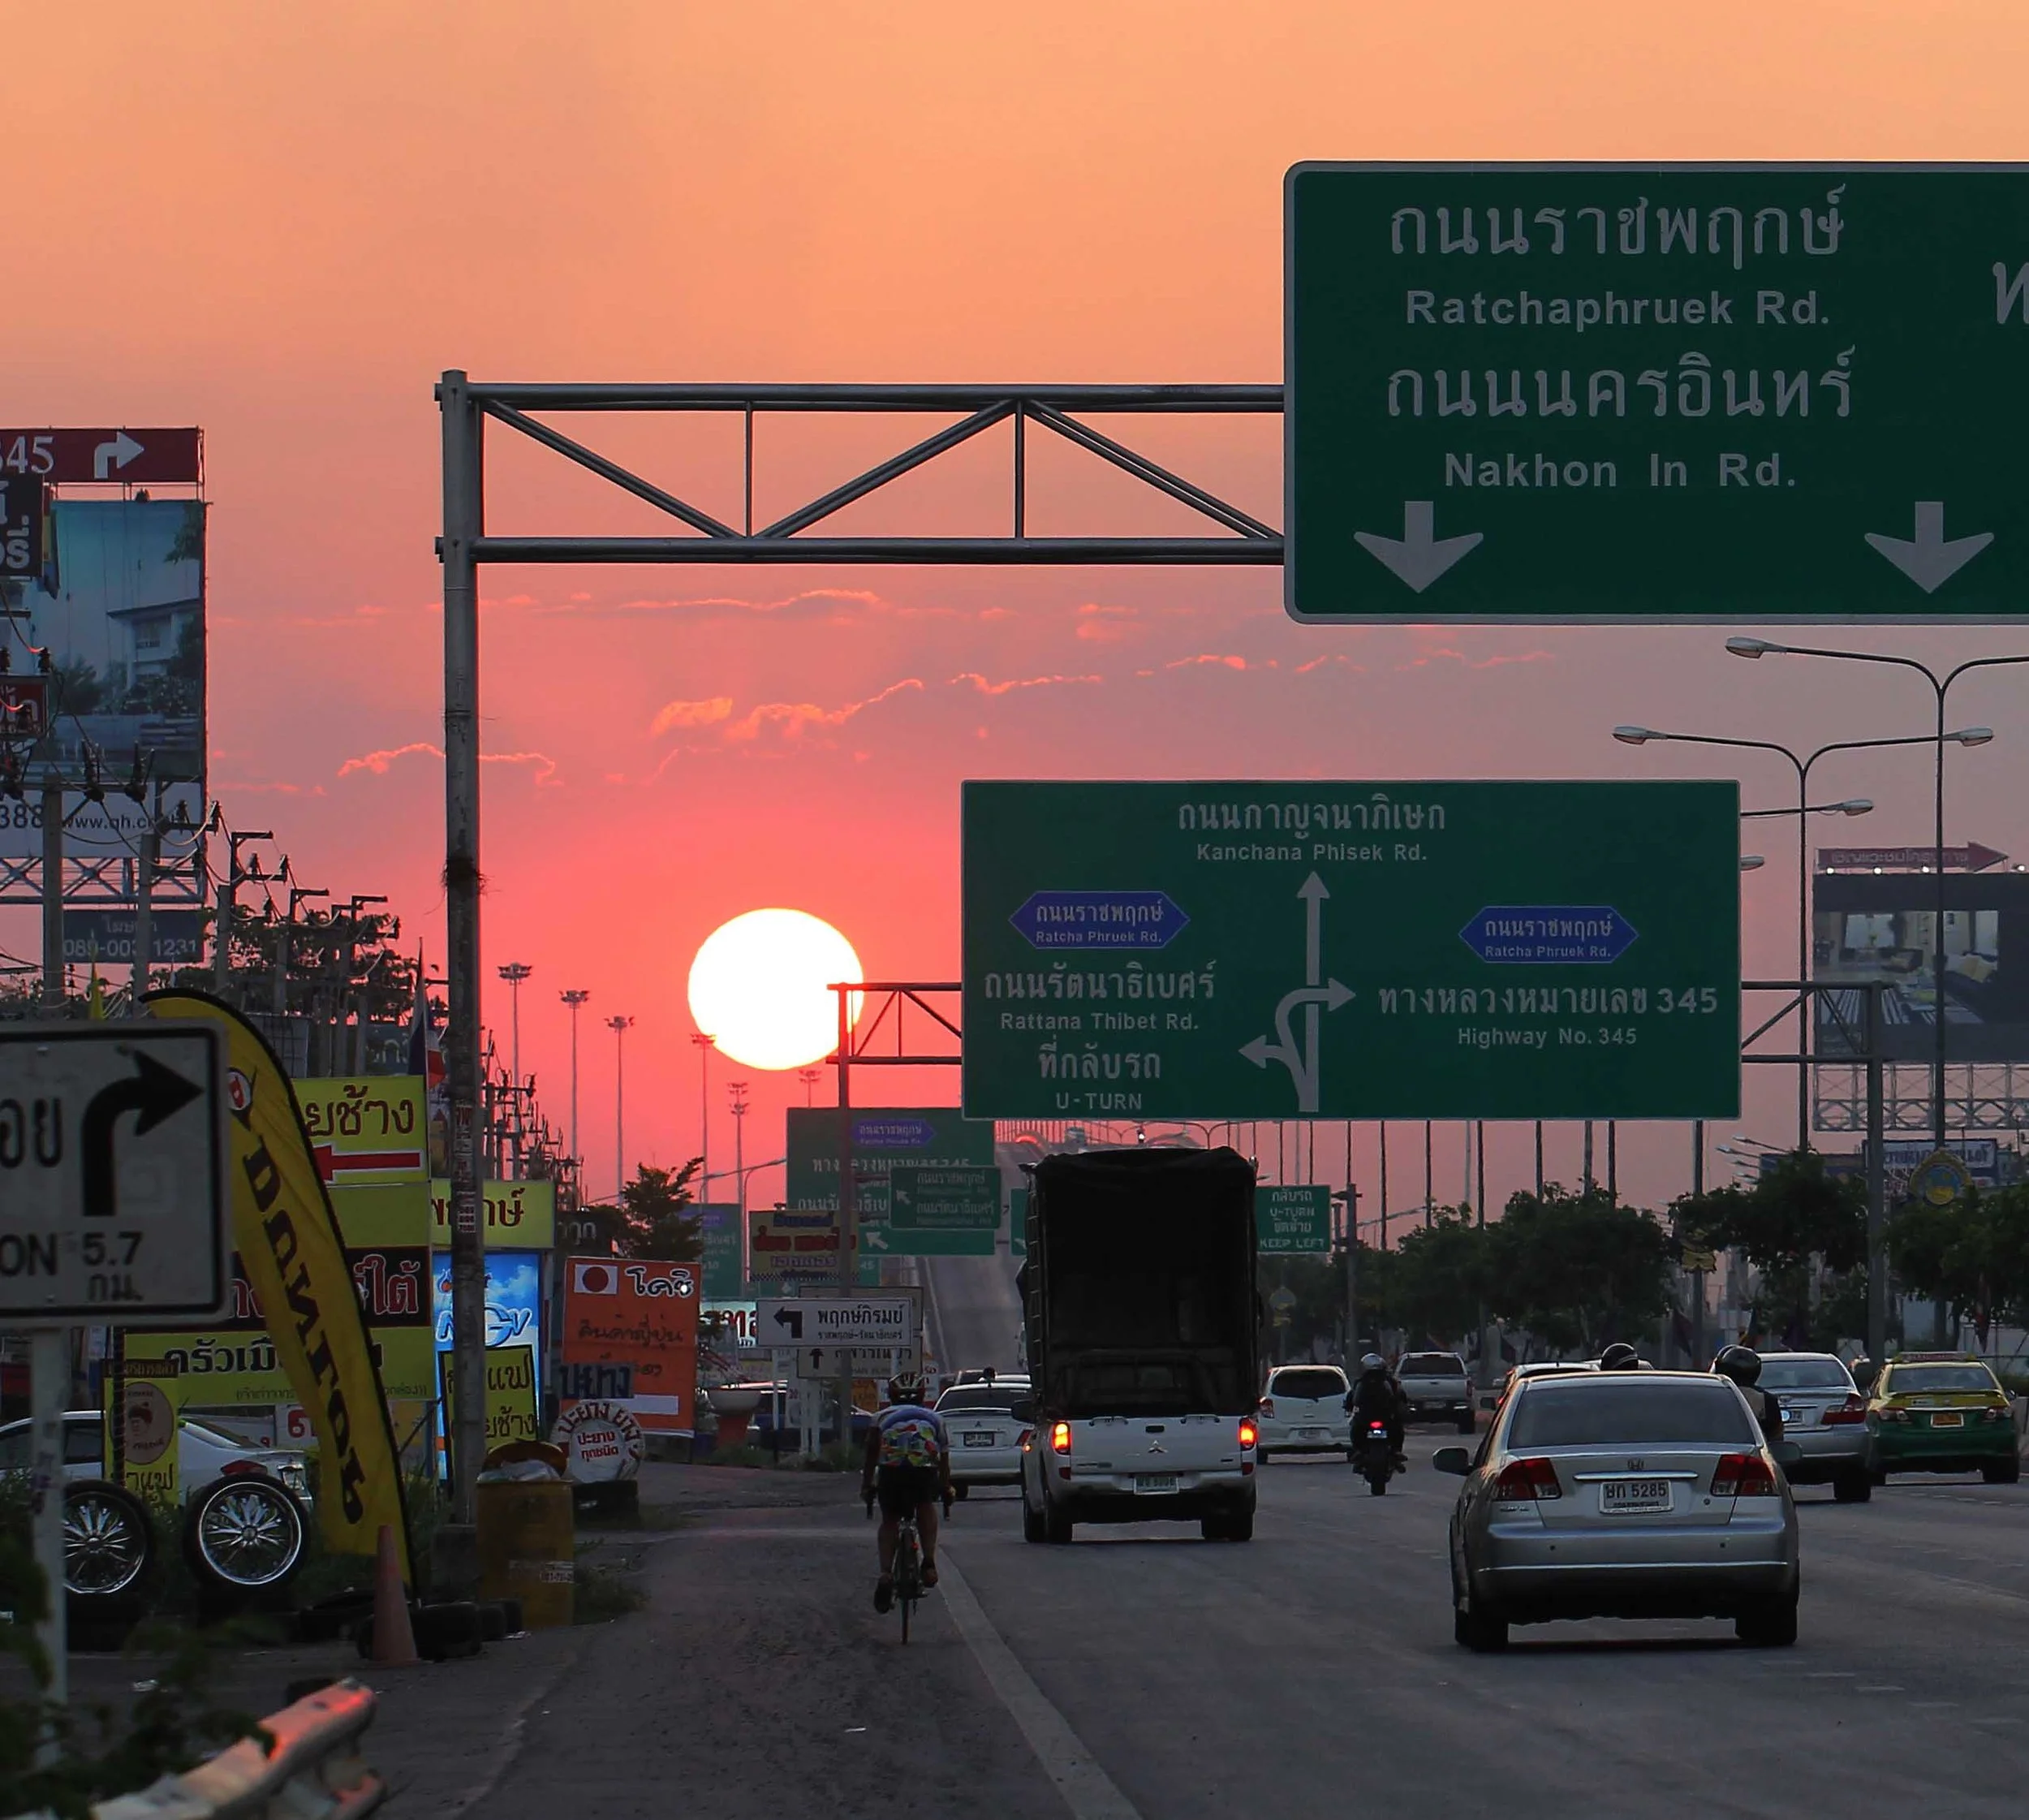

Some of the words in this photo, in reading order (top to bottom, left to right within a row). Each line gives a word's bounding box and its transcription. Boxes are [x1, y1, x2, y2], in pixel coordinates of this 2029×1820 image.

[1392, 183, 1846, 270] ถนนราชพฤกษ์
[1407, 291, 1733, 332] Ratchaphruek
[1757, 291, 1829, 324] Rd.
[1389, 345, 1855, 416] ถนนนครอินทร์
[0, 436, 55, 474] 45
[1445, 453, 1616, 486] Nakhon
[1651, 453, 1687, 486] In
[1720, 453, 1794, 486] Rd.
[1179, 793, 1445, 839] ถนนกาญจนาภิเษก
[1197, 843, 1302, 860] Kanchana
[1314, 843, 1382, 860] Phisek
[1394, 843, 1427, 860] Rd.
[1036, 899, 1163, 927] ถนนราชพฤกษ์
[1036, 931, 1083, 942] Ratcha
[1088, 931, 1134, 942] Phruek
[1140, 931, 1161, 942] Rd.
[1486, 914, 1613, 942] ถนนราชพฤกษ์
[1485, 946, 1531, 957] Ratcha
[1536, 946, 1584, 957] Phruek
[1590, 946, 1610, 956] Rd.
[984, 960, 1216, 998] ถนนรัตนาธิเบศร์
[1379, 988, 1647, 1013] ทางหลวงหมายเลข
[1657, 988, 1717, 1013] 345
[1001, 1012, 1080, 1029] Rattana
[1092, 1012, 1156, 1029] Thibet
[1166, 1013, 1198, 1030] Rd.
[1458, 1028, 1547, 1049] Highway
[1559, 1028, 1592, 1044] No.
[1599, 1028, 1636, 1045] 345
[1038, 1034, 1160, 1079] ที่กลับรถ
[1056, 1093, 1141, 1110] U-TURN
[83, 1231, 144, 1267] 5.7
[1631, 1482, 1667, 1498] 5285
